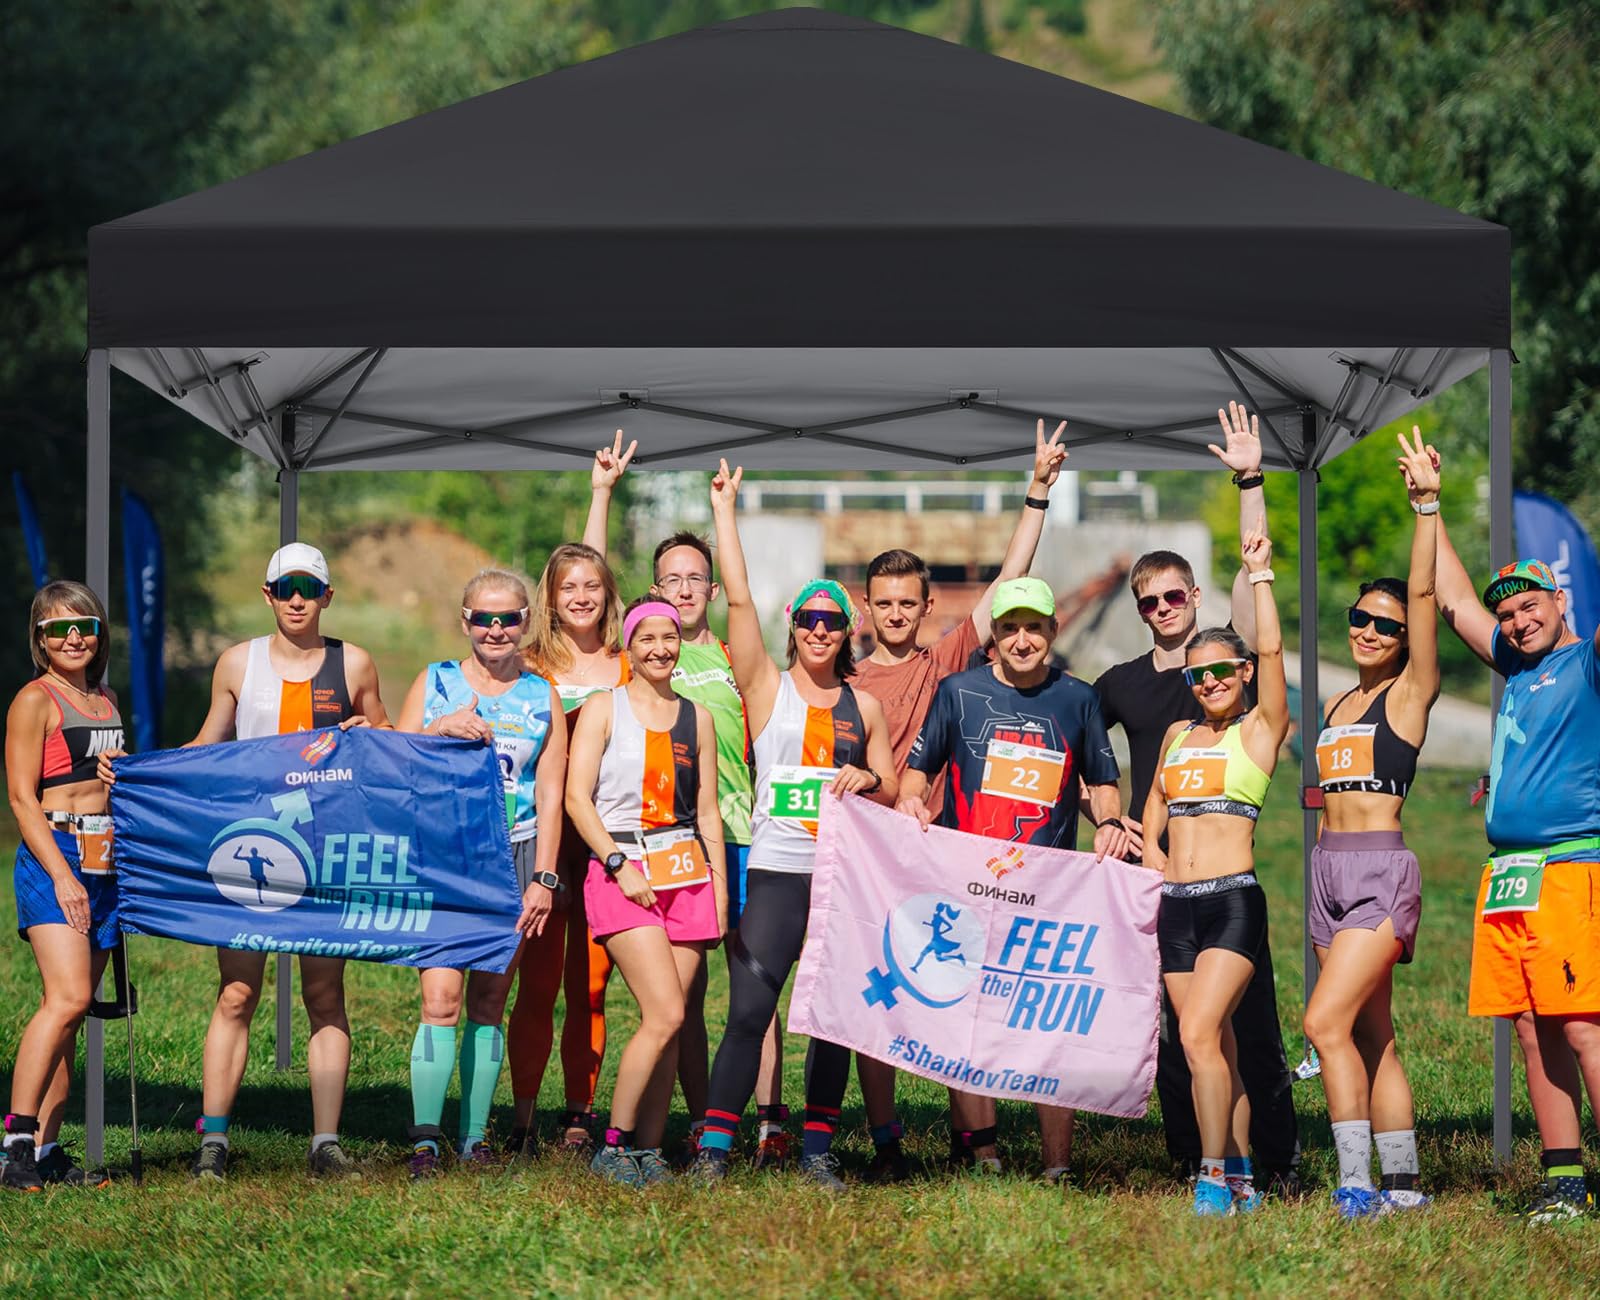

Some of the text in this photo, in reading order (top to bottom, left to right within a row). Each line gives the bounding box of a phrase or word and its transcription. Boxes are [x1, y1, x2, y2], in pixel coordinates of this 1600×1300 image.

[85, 729, 125, 757] NIKE
[1330, 747, 1353, 770] 18
[1010, 766, 1041, 792] 22
[1179, 768, 1205, 790] 75
[321, 833, 417, 884] FEEL
[668, 851, 695, 877] 26
[1495, 876, 1528, 901] 279
[343, 889, 433, 932] RUN
[998, 915, 1100, 975] FEEL
[980, 973, 1105, 1036] the RUN
[887, 1034, 1060, 1097] #SharikovTeam
